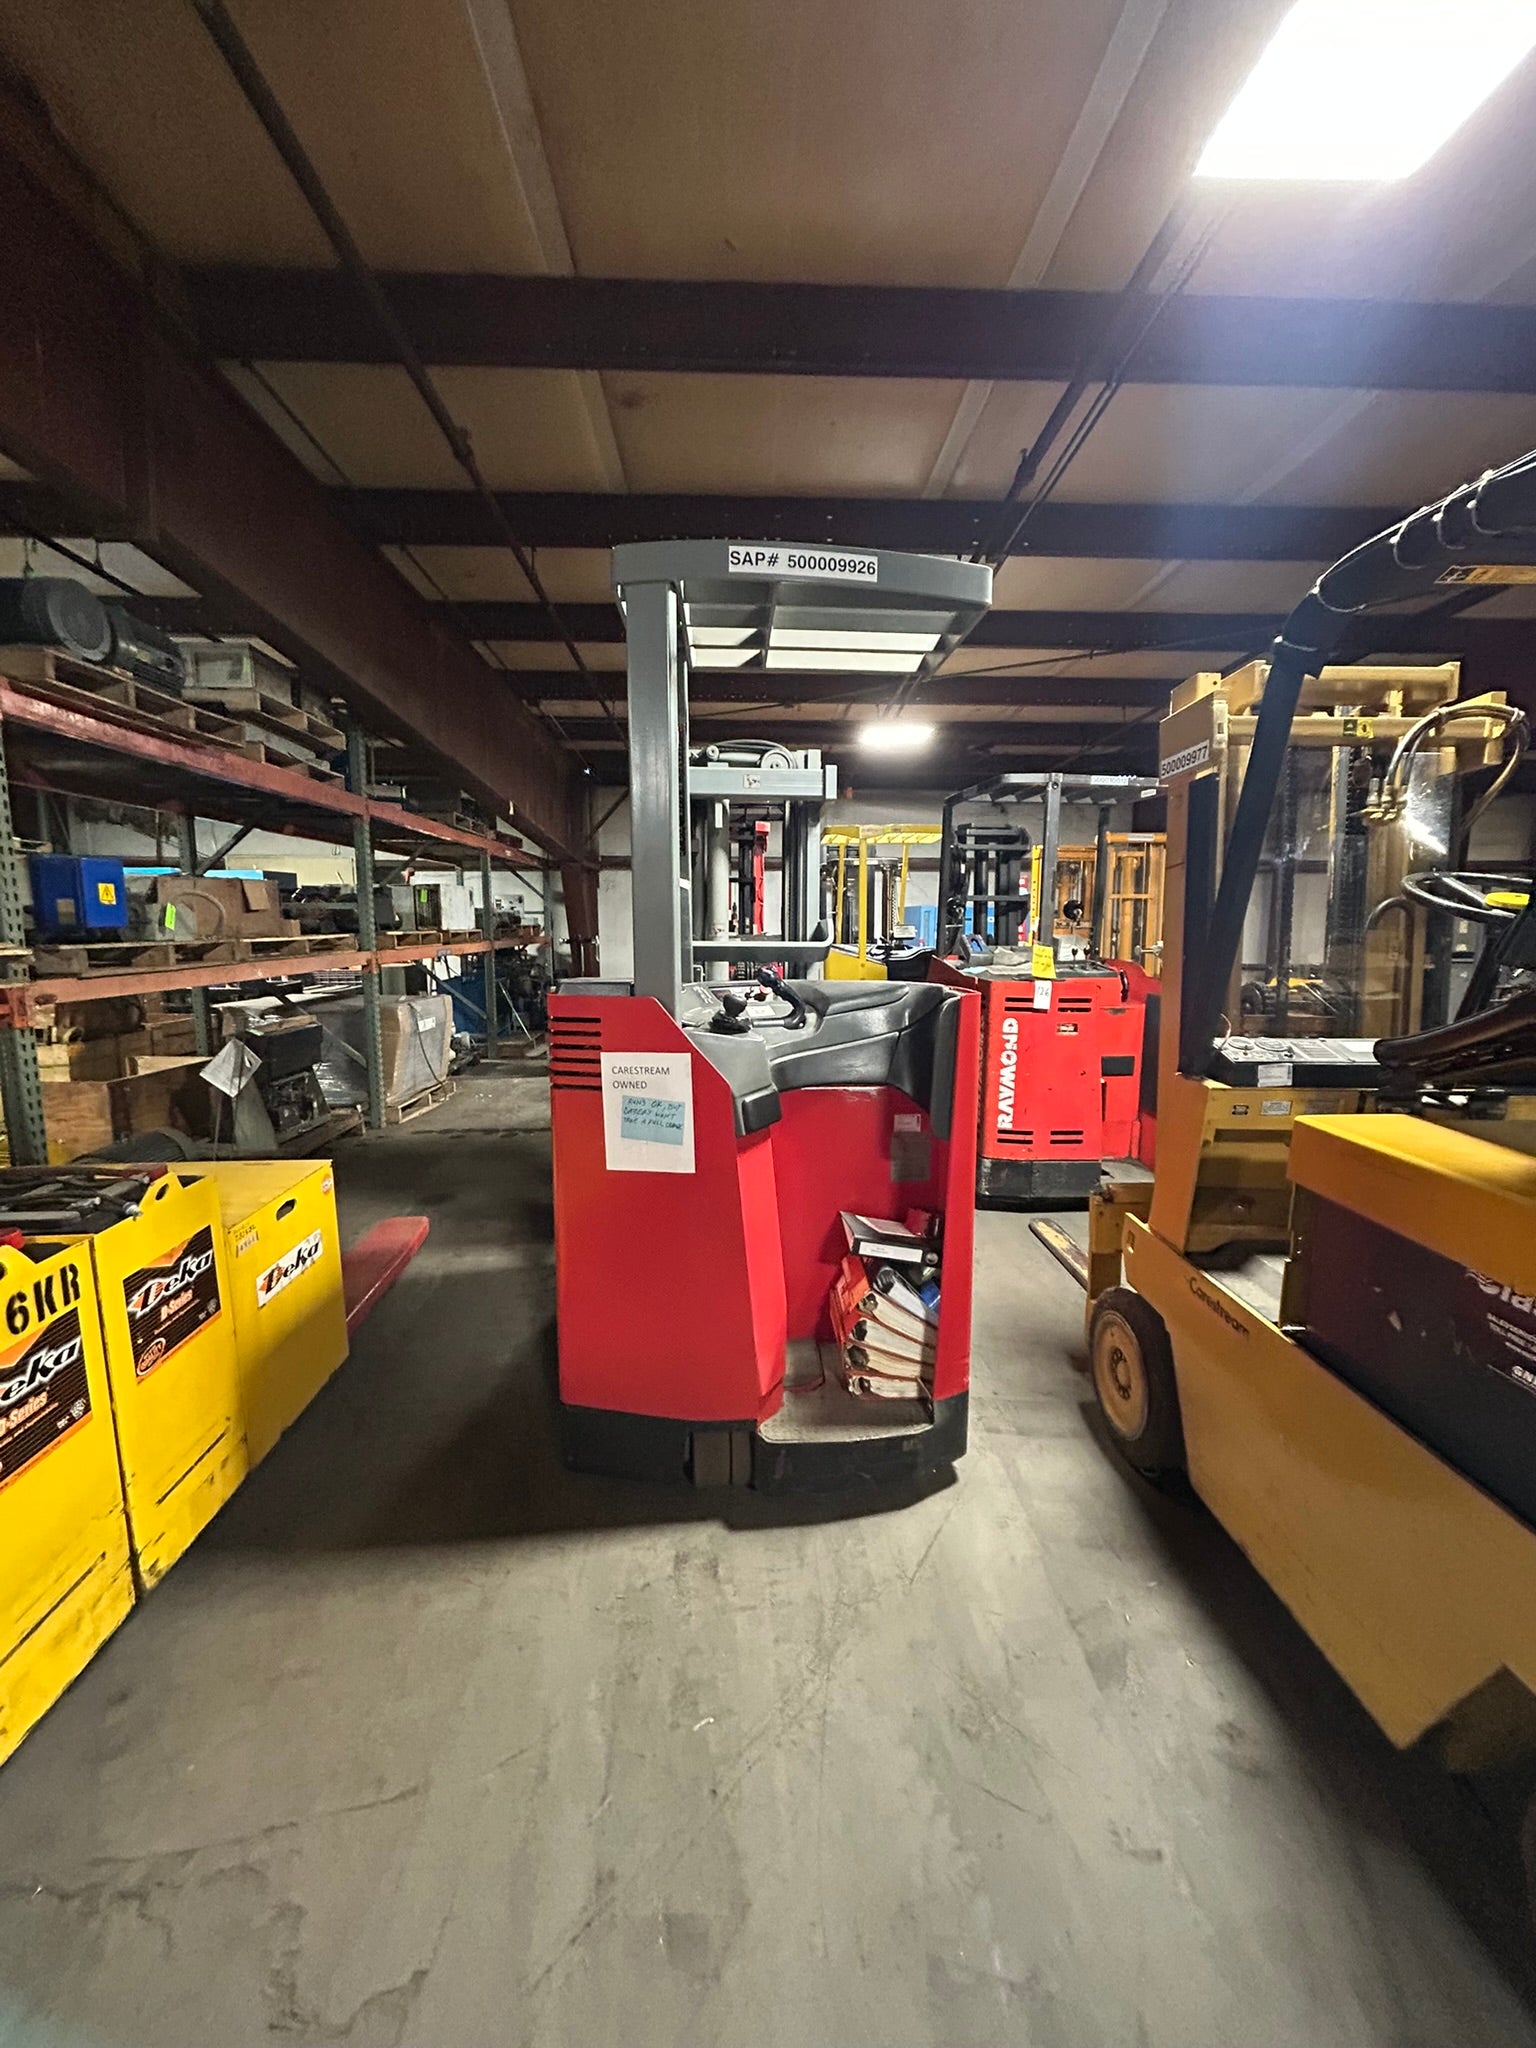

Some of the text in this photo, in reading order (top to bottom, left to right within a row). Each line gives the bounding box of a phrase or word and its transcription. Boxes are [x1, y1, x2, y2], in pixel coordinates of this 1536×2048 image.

[730, 551, 876, 575] SAP# 500009926
[1161, 745, 1208, 777] 500009977
[611, 1066, 671, 1076] CARESTREAM
[611, 1080, 648, 1089] OWNED
[996, 1017, 1019, 1130] RAYMOND
[131, 1251, 212, 1314] Deka
[258, 1241, 320, 1295] Deka
[6, 1263, 81, 1335] 6KR
